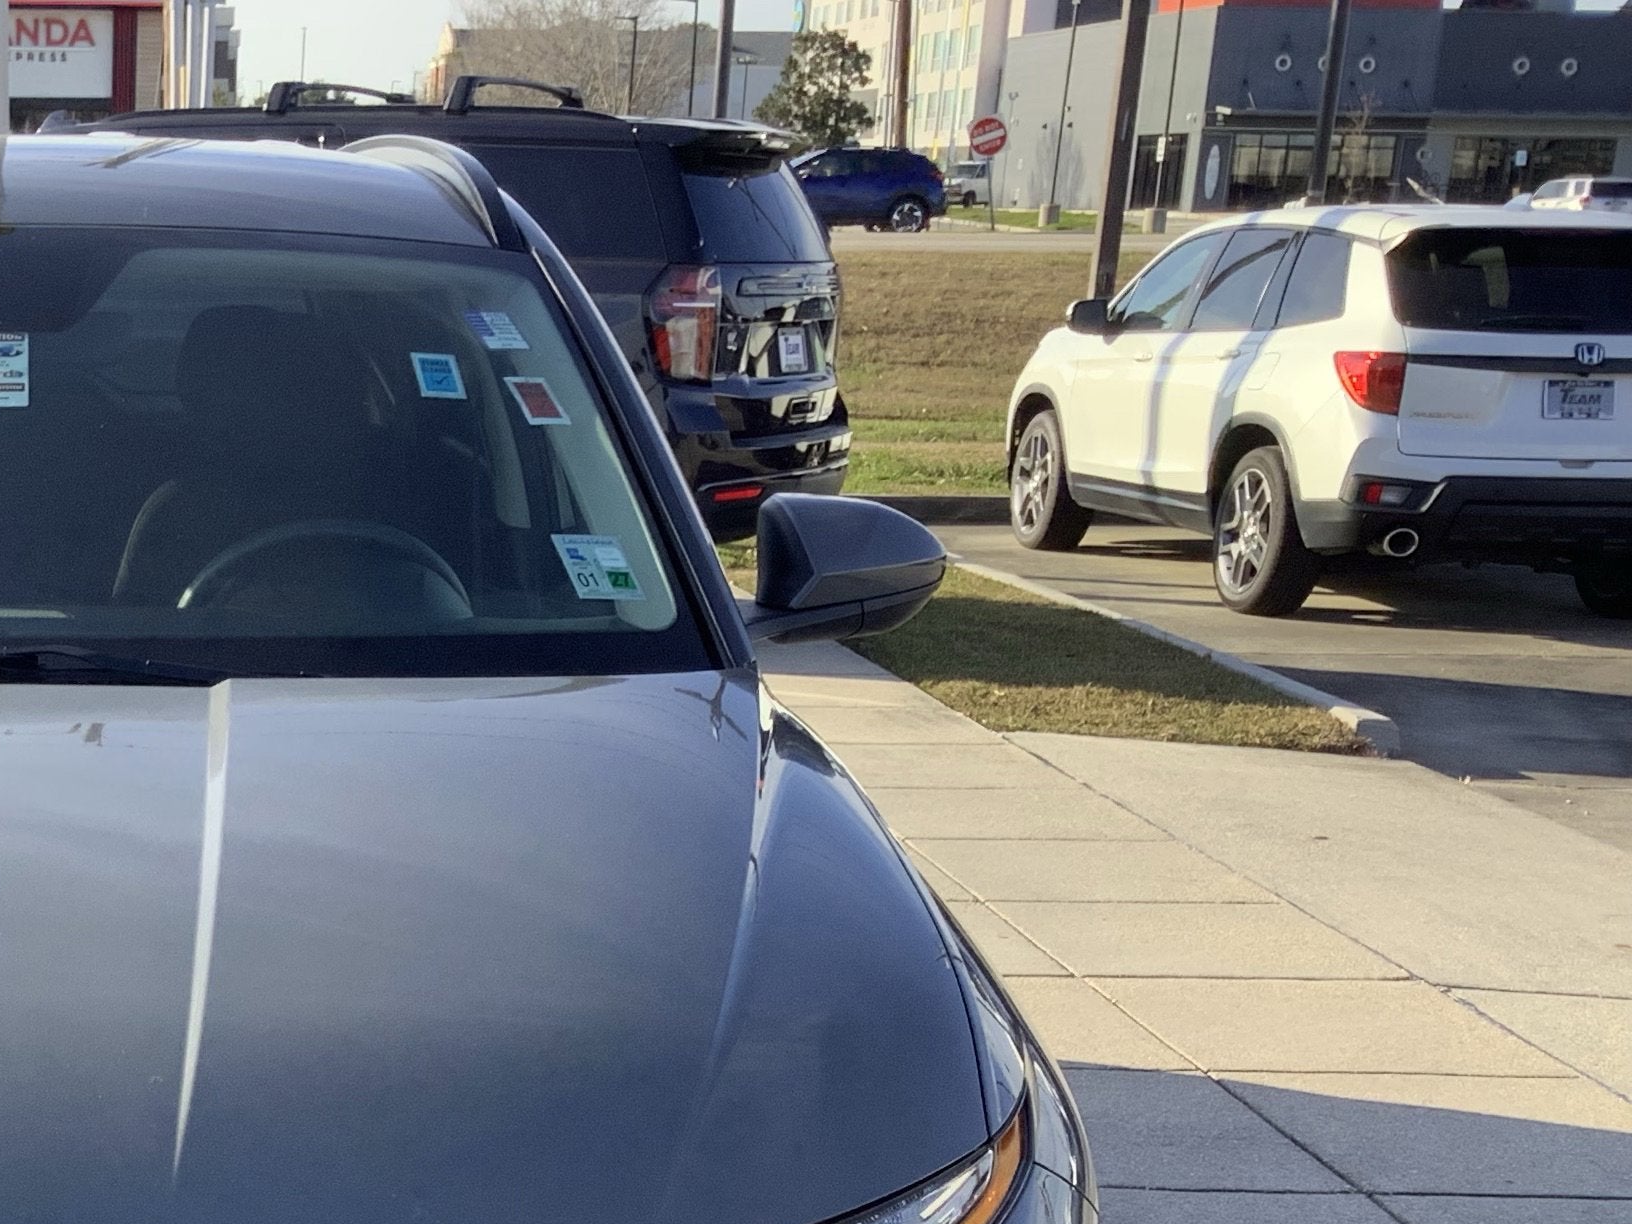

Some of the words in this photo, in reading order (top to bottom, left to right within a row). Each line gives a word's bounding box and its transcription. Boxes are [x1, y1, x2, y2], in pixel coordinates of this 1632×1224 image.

[9, 18, 95, 47] NDA
[9, 52, 67, 62] PRESS
[1560, 388, 1602, 405] TEAM
[576, 572, 600, 588] 01
